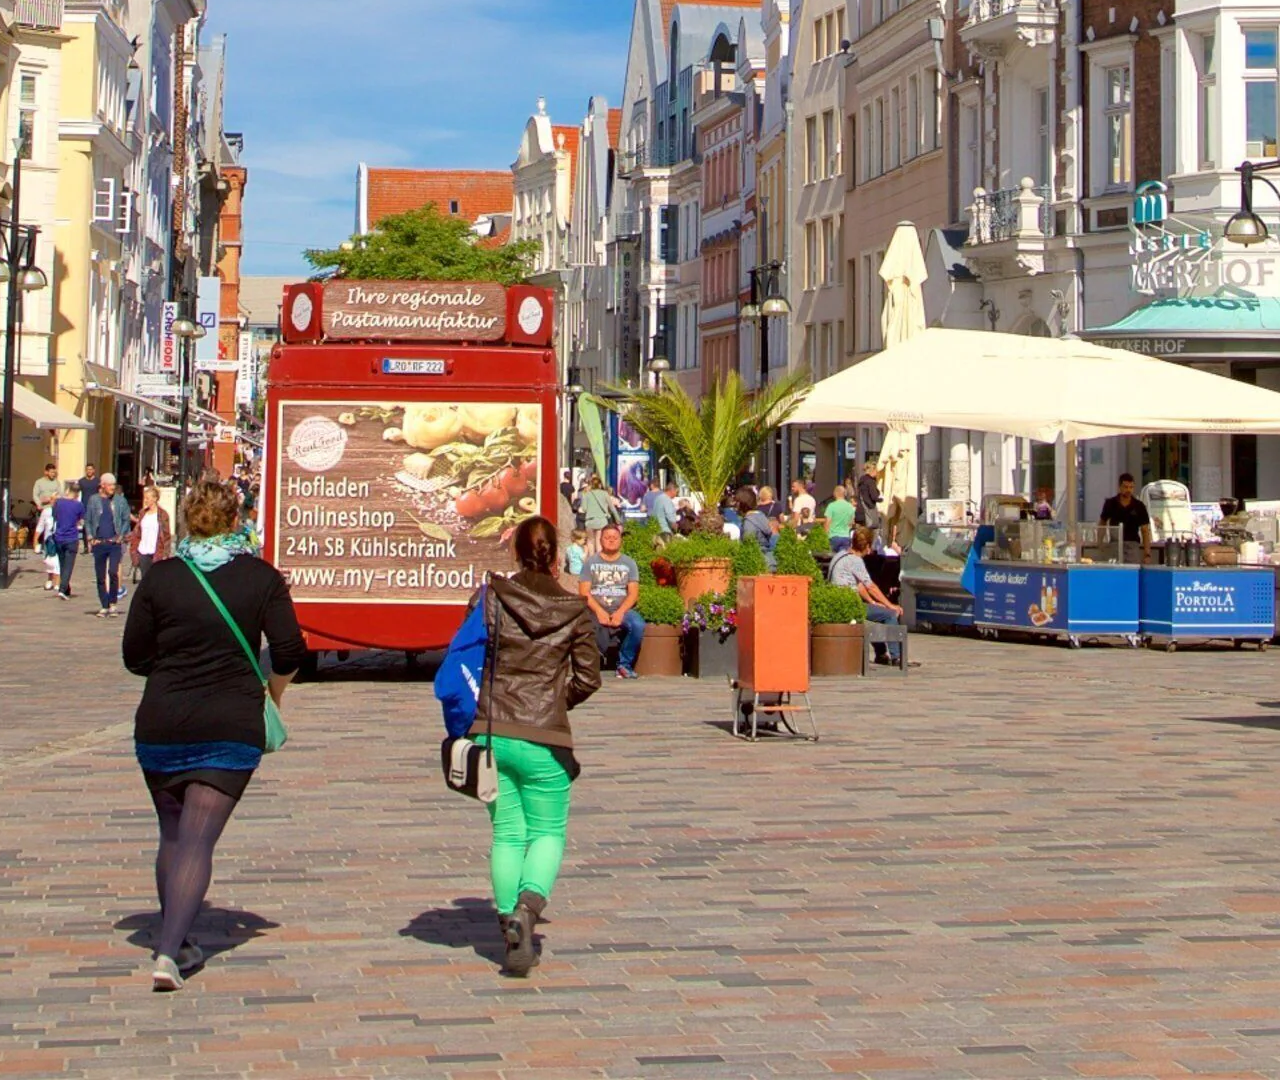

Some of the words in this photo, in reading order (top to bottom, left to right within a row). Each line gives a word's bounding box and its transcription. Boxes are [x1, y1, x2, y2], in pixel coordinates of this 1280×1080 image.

[1204, 257, 1276, 287] HOF
[346, 287, 388, 305] Ihre
[391, 287, 486, 310] regionale
[331, 311, 498, 331] Pastamanufaktur
[1154, 338, 1185, 354] HOF
[426, 361, 444, 372] 222
[287, 476, 370, 498] Hofladen
[287, 505, 395, 531] Onlineshop
[286, 537, 319, 556] 24h
[324, 537, 345, 556] SB
[350, 535, 457, 558] Kühlschrank
[1192, 580, 1218, 592] Bistro
[1176, 592, 1234, 607] PORTOLA
